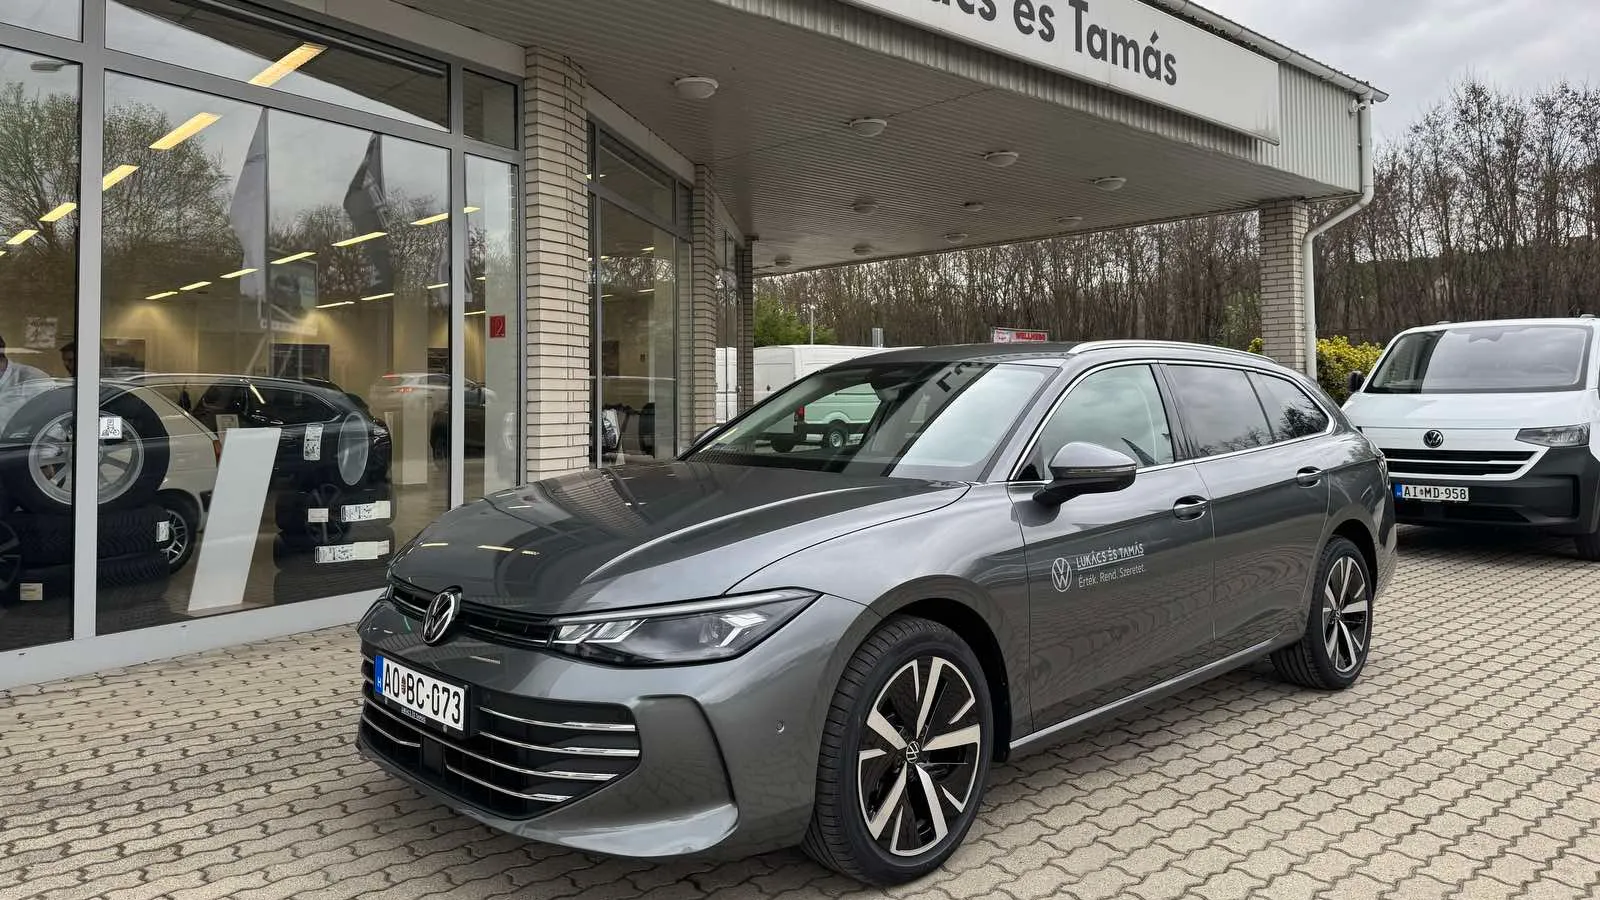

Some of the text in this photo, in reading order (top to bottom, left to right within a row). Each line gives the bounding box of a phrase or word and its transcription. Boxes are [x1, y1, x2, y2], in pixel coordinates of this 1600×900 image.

[1068, 0, 1178, 86] Tamás
[1076, 541, 1145, 568] LUKÁCS ÉS TAMÁS
[1078, 573, 1098, 588] Érték.
[1099, 571, 1118, 583] Rend.
